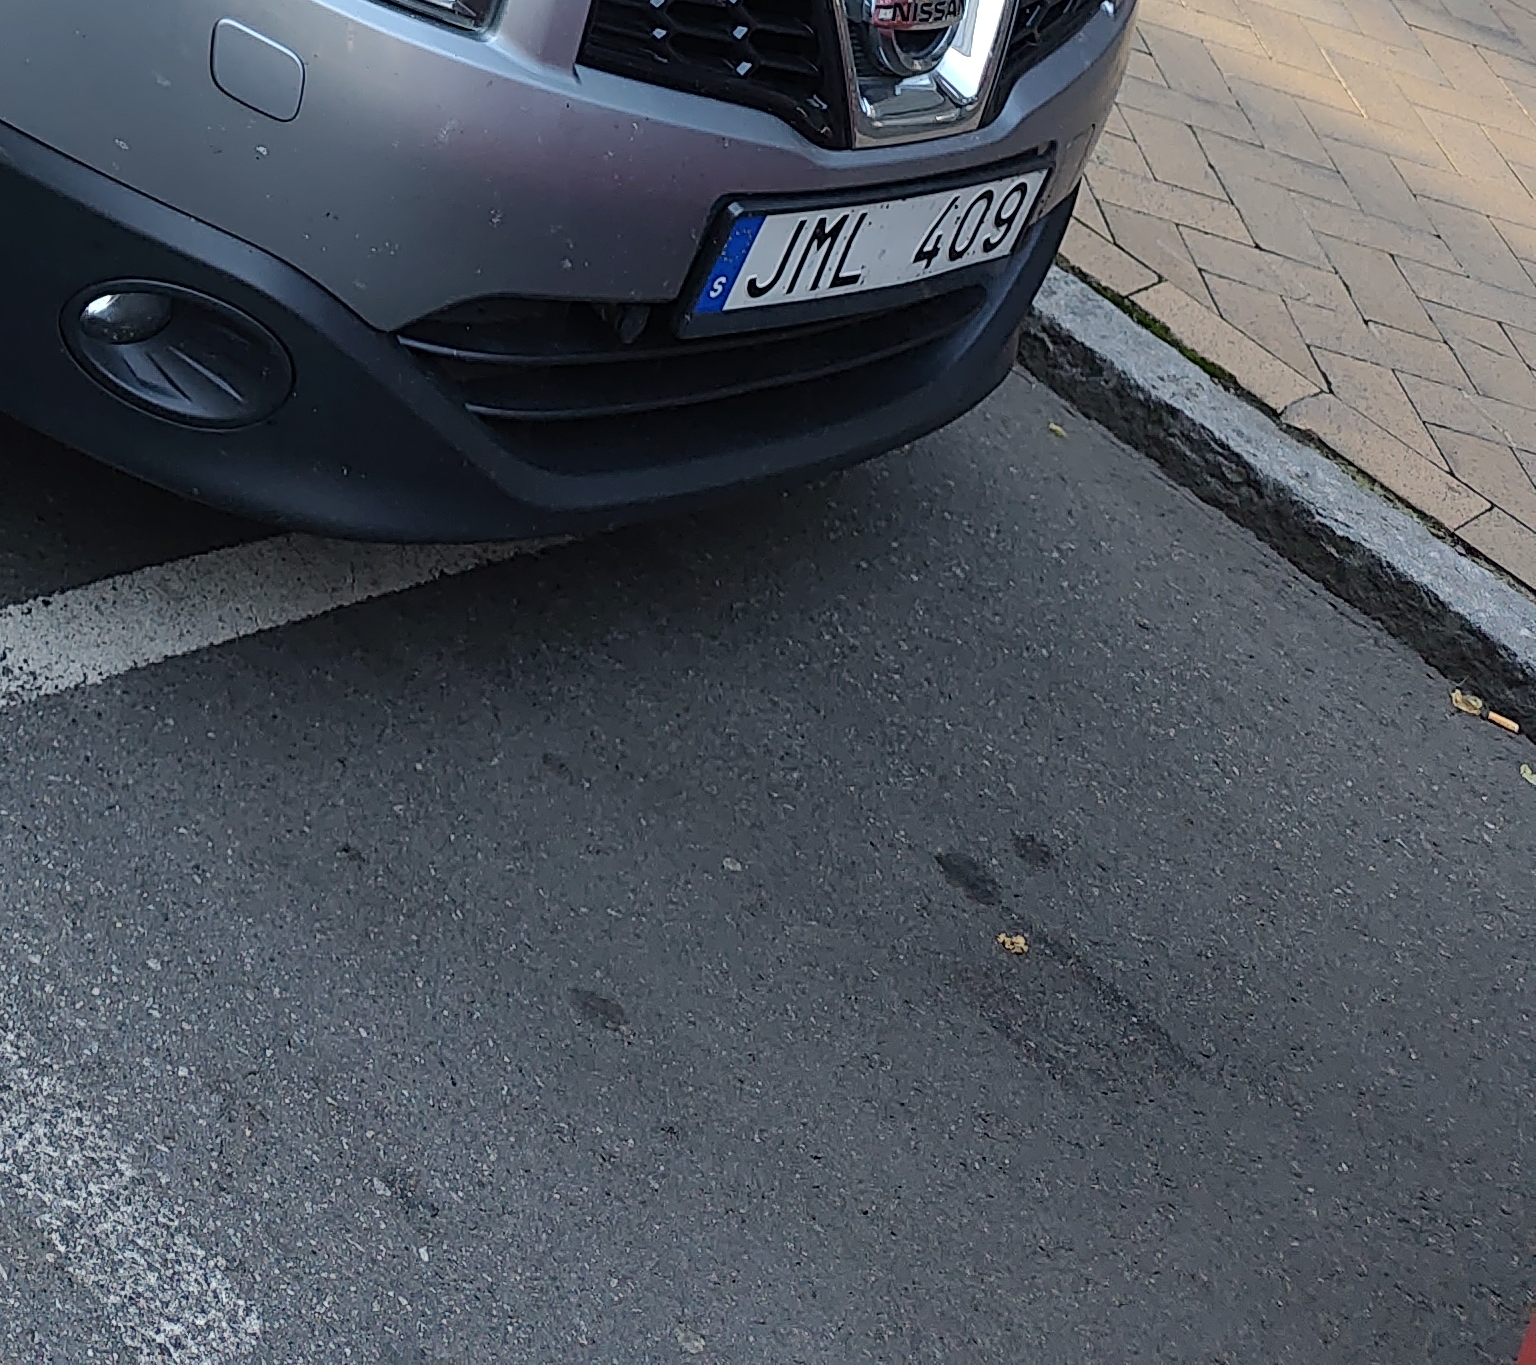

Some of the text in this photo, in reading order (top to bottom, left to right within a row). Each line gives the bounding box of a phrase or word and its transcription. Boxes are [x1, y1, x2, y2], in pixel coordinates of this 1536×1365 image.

[746, 182, 1028, 298] JML 409
[709, 276, 726, 298] S
